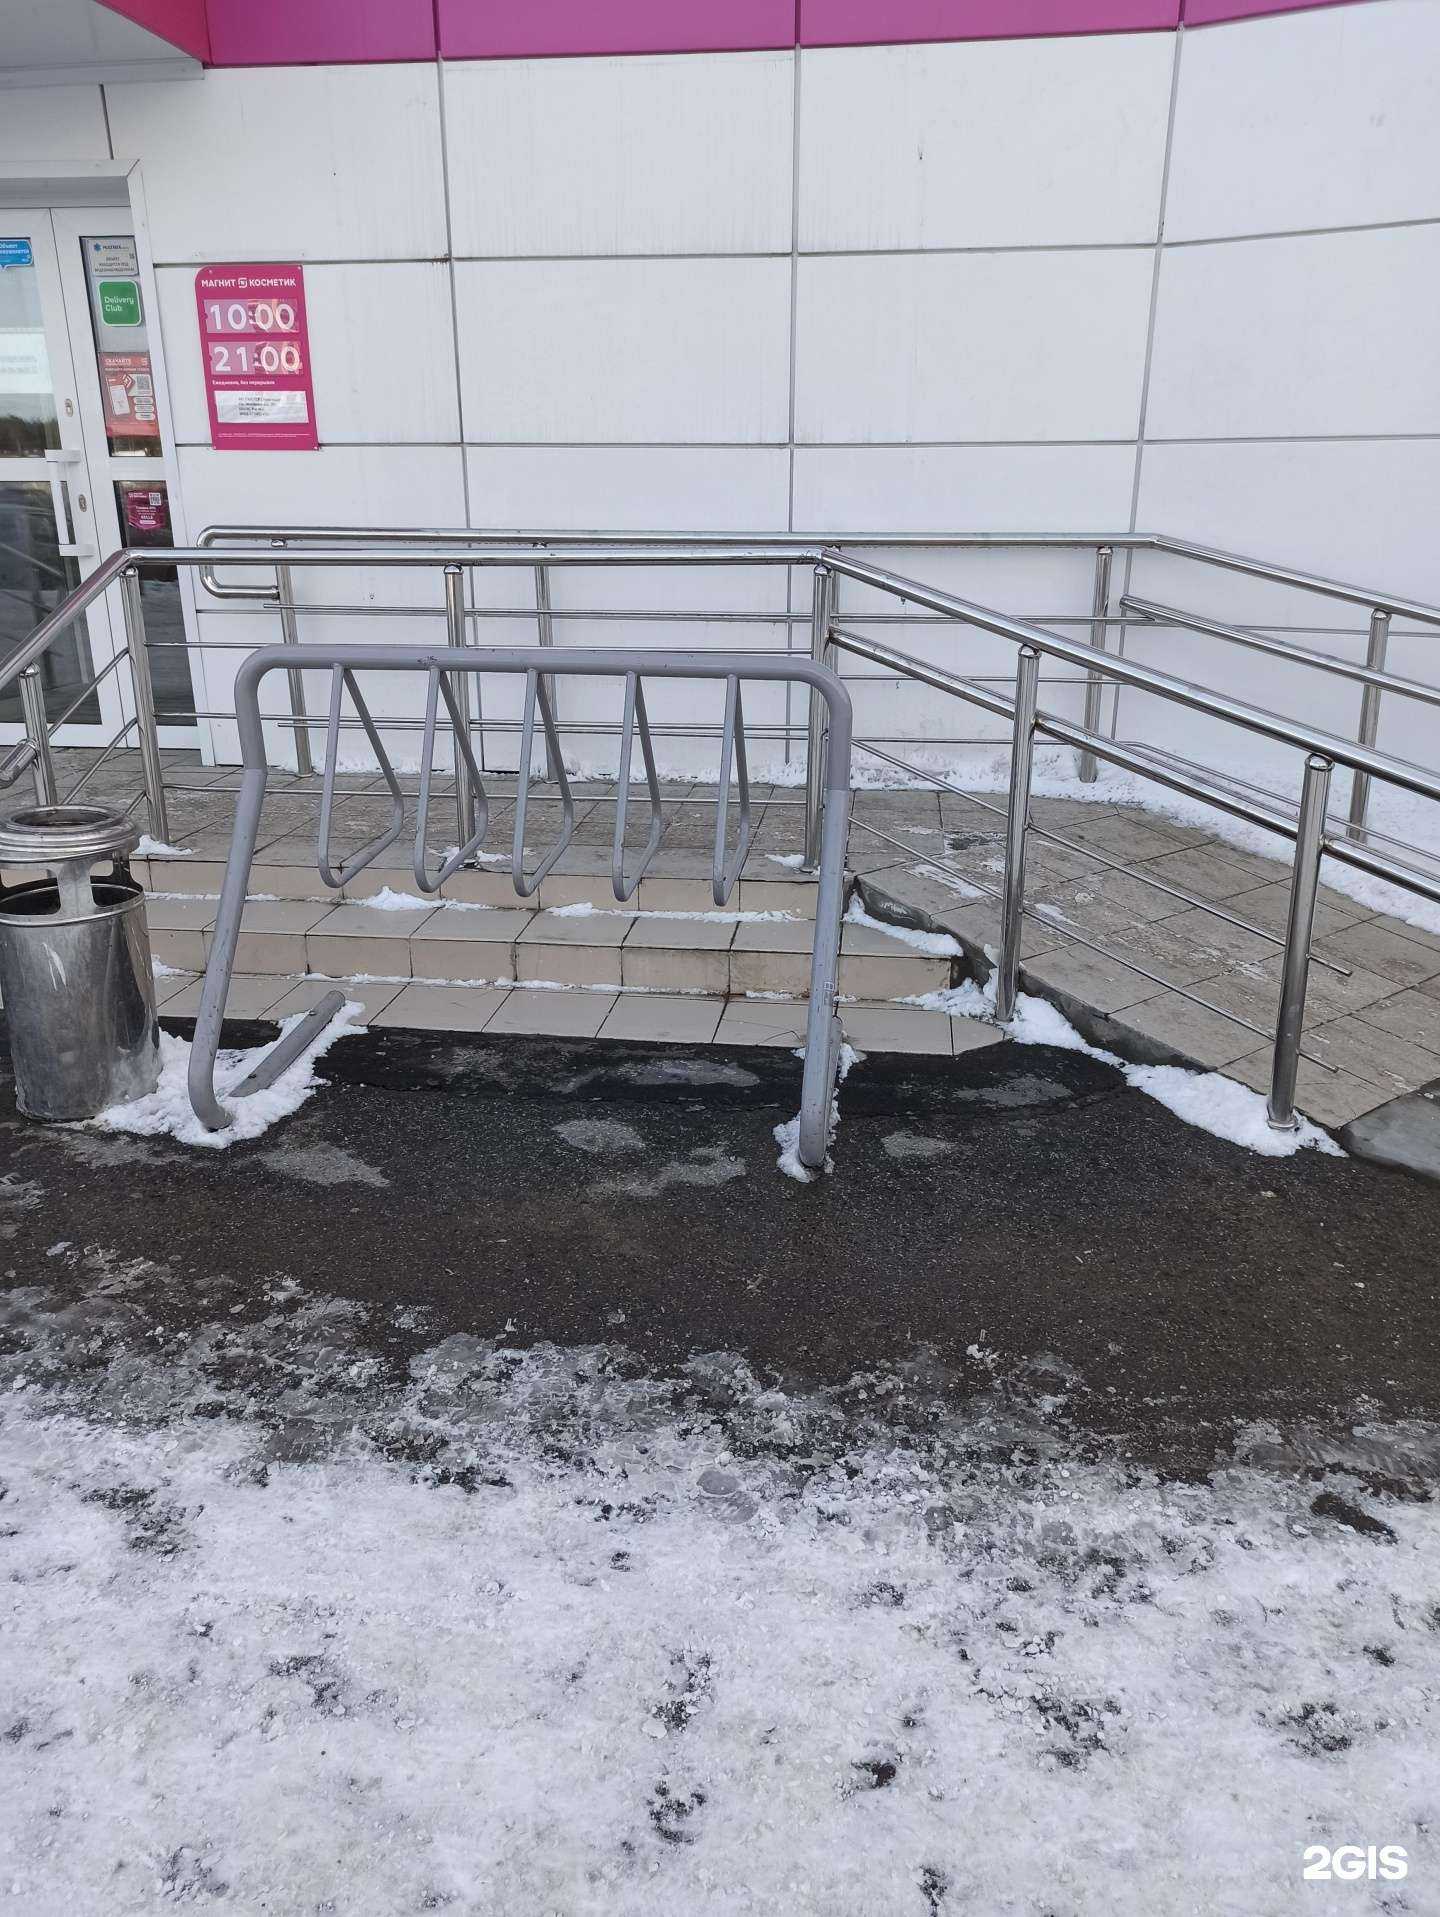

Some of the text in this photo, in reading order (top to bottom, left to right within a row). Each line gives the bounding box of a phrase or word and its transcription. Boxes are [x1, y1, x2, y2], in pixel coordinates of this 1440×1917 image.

[201, 278, 296, 287] МАГНИТ КОСМЕТИК
[104, 296, 134, 304] Delivery
[105, 304, 122, 312] Club
